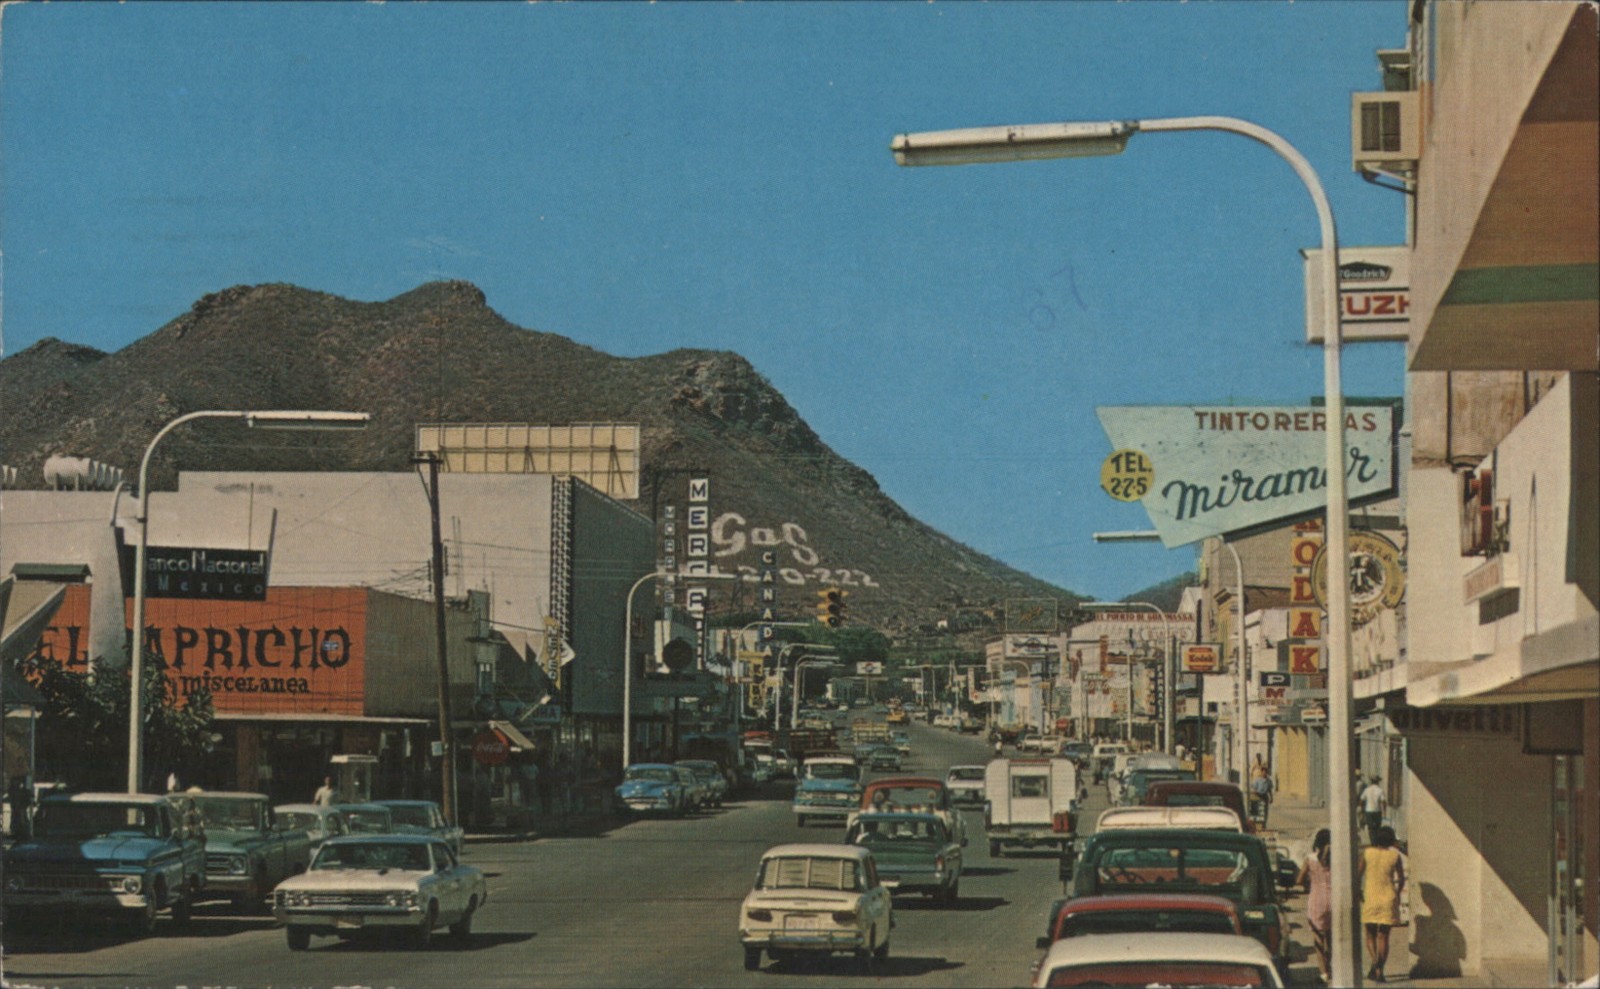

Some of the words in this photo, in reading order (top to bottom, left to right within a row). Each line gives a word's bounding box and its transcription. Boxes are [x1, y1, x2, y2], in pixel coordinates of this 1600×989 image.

[1343, 269, 1387, 278] Goodrich
[1194, 411, 1377, 433] TINTORERAS
[148, 557, 190, 572] anco
[191, 550, 264, 575] Nacional
[761, 551, 774, 657] CANADA
[124, 623, 353, 671] APRICHO
